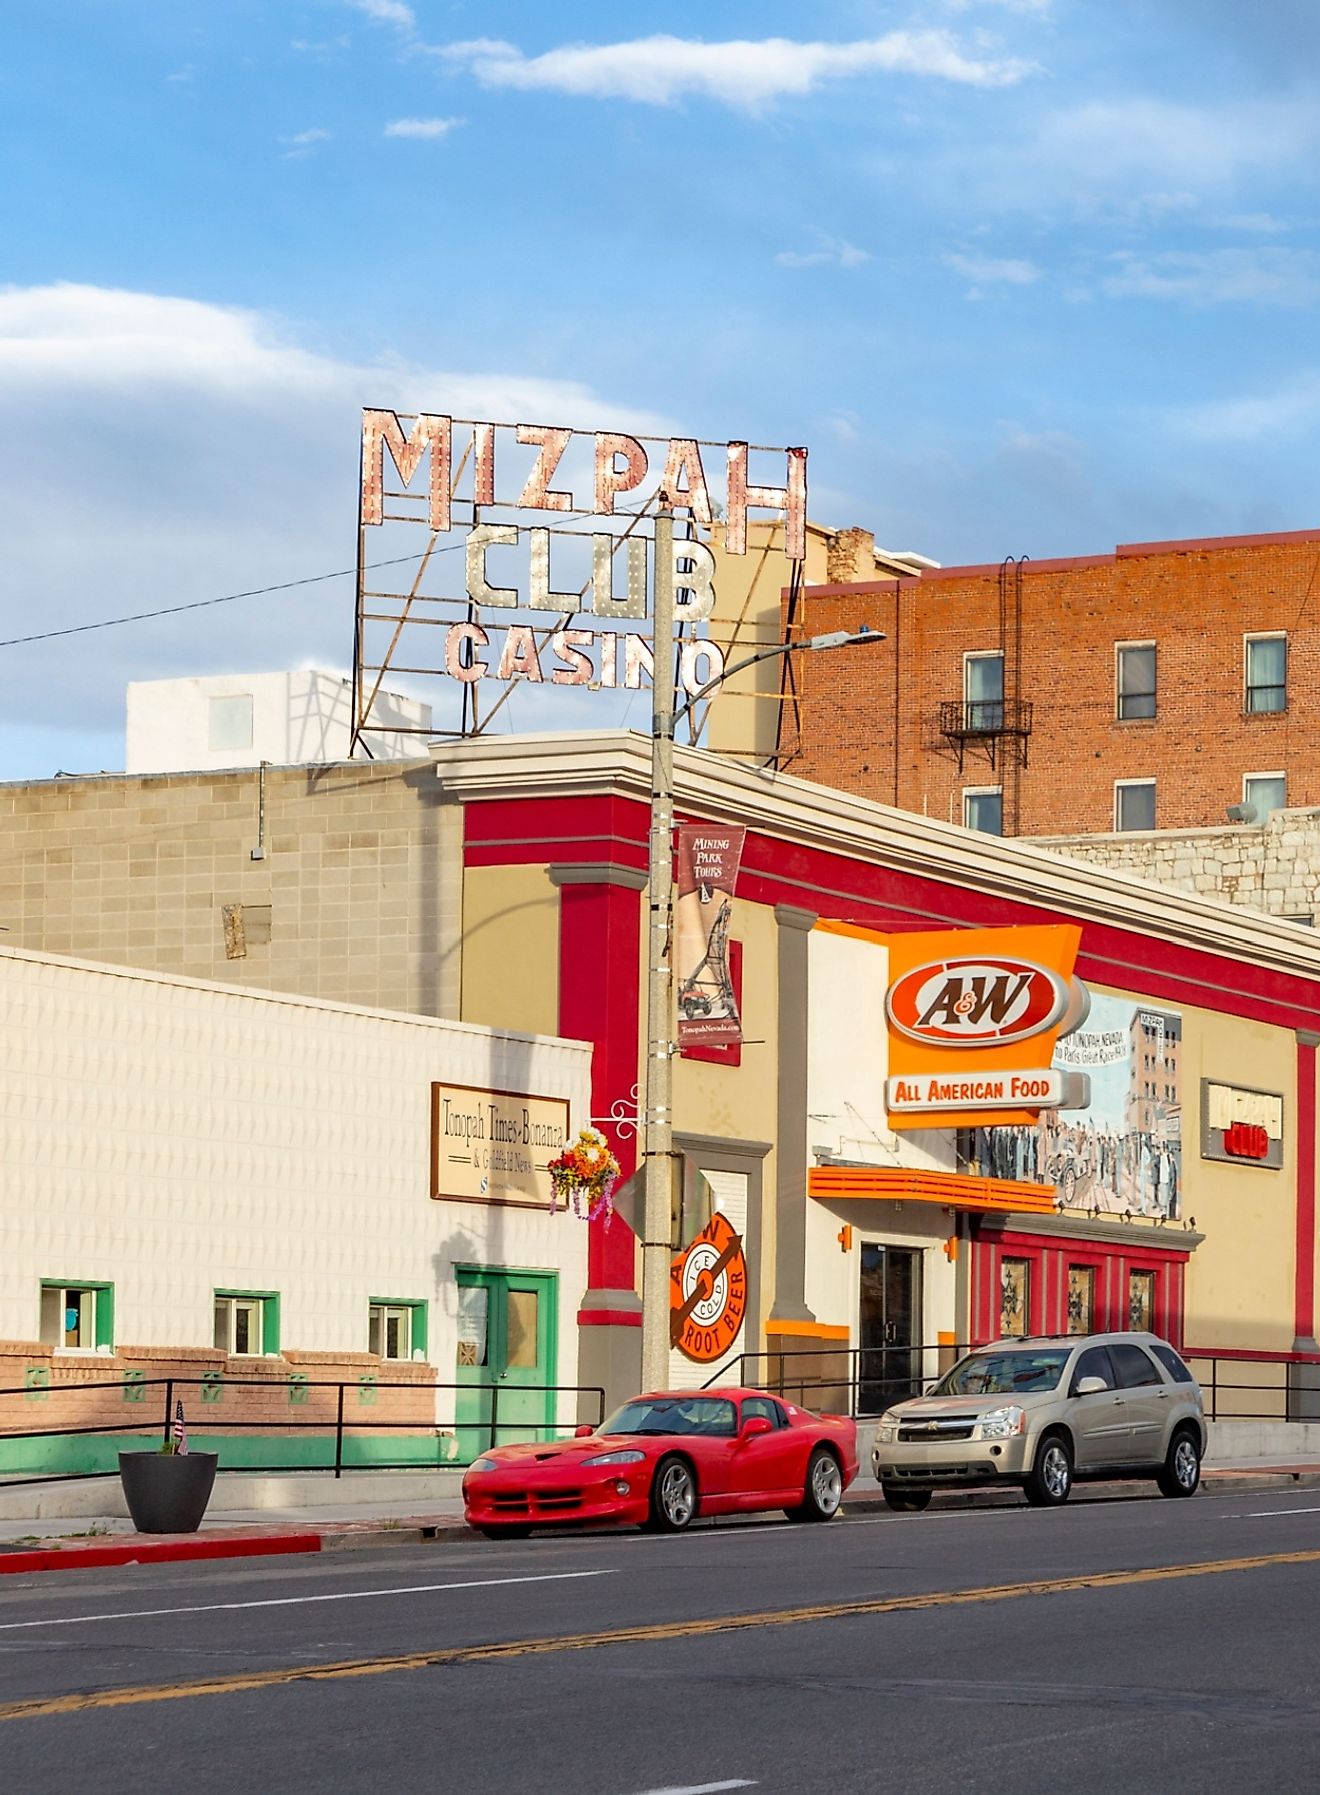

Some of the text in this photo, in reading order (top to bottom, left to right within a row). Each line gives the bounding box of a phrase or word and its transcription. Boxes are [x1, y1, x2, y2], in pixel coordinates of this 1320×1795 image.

[362, 407, 808, 559] MIZPAH
[465, 524, 716, 622] CLUB
[445, 622, 725, 699] CASINO
[692, 838, 730, 850] MINING
[696, 852, 723, 865] PARK
[693, 866, 722, 879] TOURS
[915, 972, 1034, 1027] A&W
[895, 1077, 1050, 1103] ALL AMERICAN FOOD
[443, 1098, 485, 1148] Tonopah
[690, 1255, 710, 1281] ICE
[700, 1284, 723, 1316] COLD
[724, 1271, 744, 1333] BEER
[684, 1325, 721, 1354] ROOT
